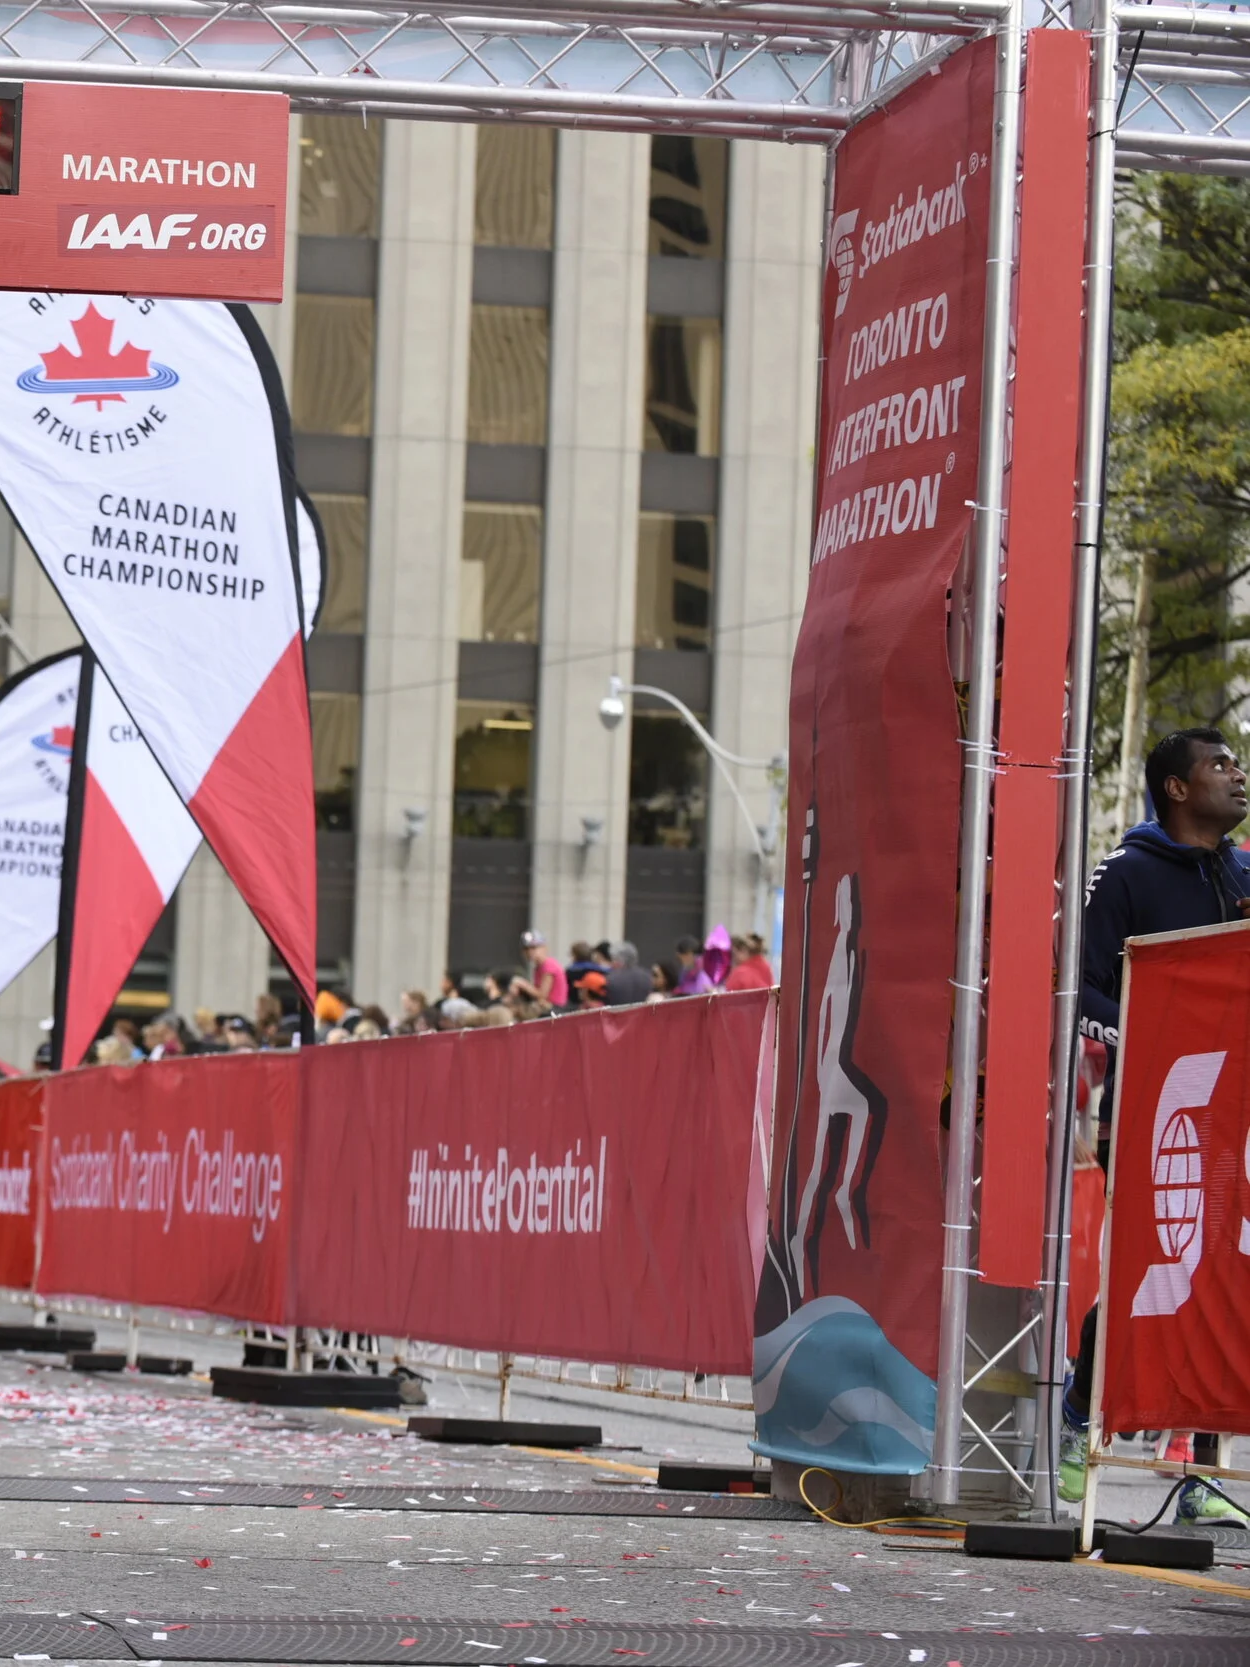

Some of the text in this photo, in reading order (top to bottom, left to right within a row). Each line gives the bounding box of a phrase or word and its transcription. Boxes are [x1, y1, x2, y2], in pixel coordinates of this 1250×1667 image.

[62, 154, 256, 189] MARATHON
[67, 213, 267, 250] IAAF.ORG
[844, 291, 949, 387] TORONTO
[33, 405, 167, 454] ATHLÉTISME
[827, 375, 966, 478] ATERFRONT
[98, 493, 237, 534] CANADIAN
[91, 524, 239, 566] MARATHON
[63, 553, 266, 601] CHAMPIONSHIP
[51, 1127, 283, 1243] Scotiabank Charity Challenge
